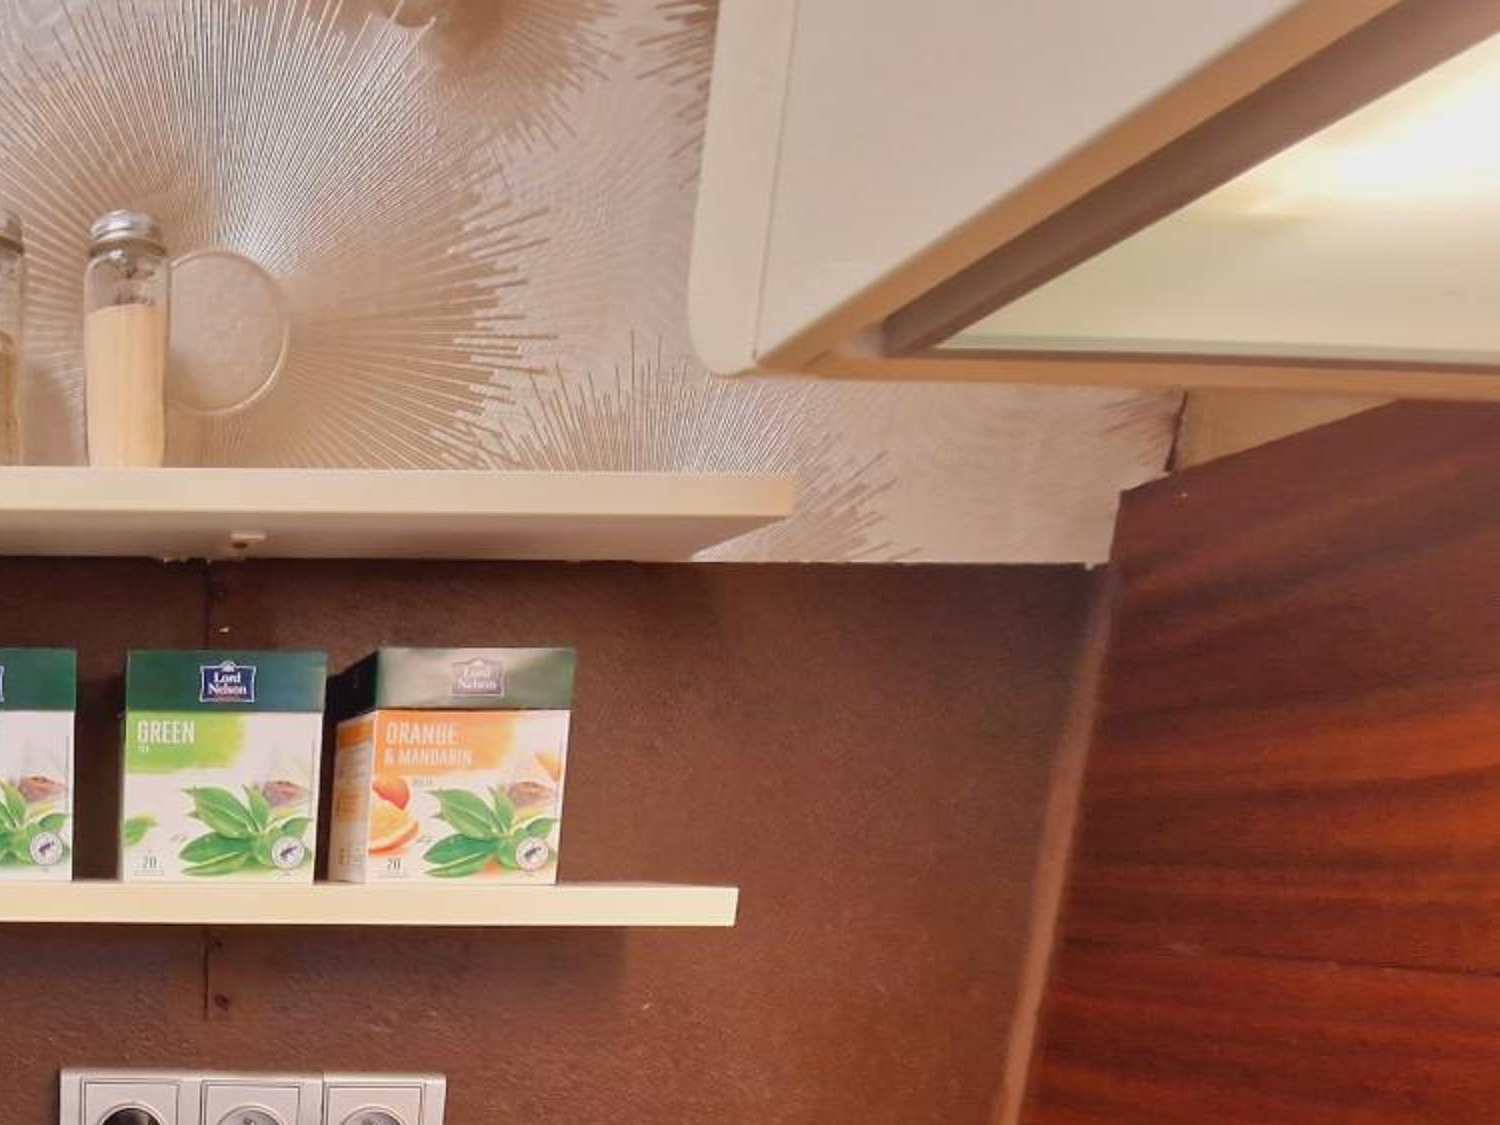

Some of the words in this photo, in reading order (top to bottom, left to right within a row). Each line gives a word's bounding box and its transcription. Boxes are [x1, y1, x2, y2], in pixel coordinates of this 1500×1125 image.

[213, 671, 242, 683] Lord
[208, 682, 247, 695] Nelson
[137, 719, 196, 744] GREEN
[385, 722, 457, 744] ORANGE
